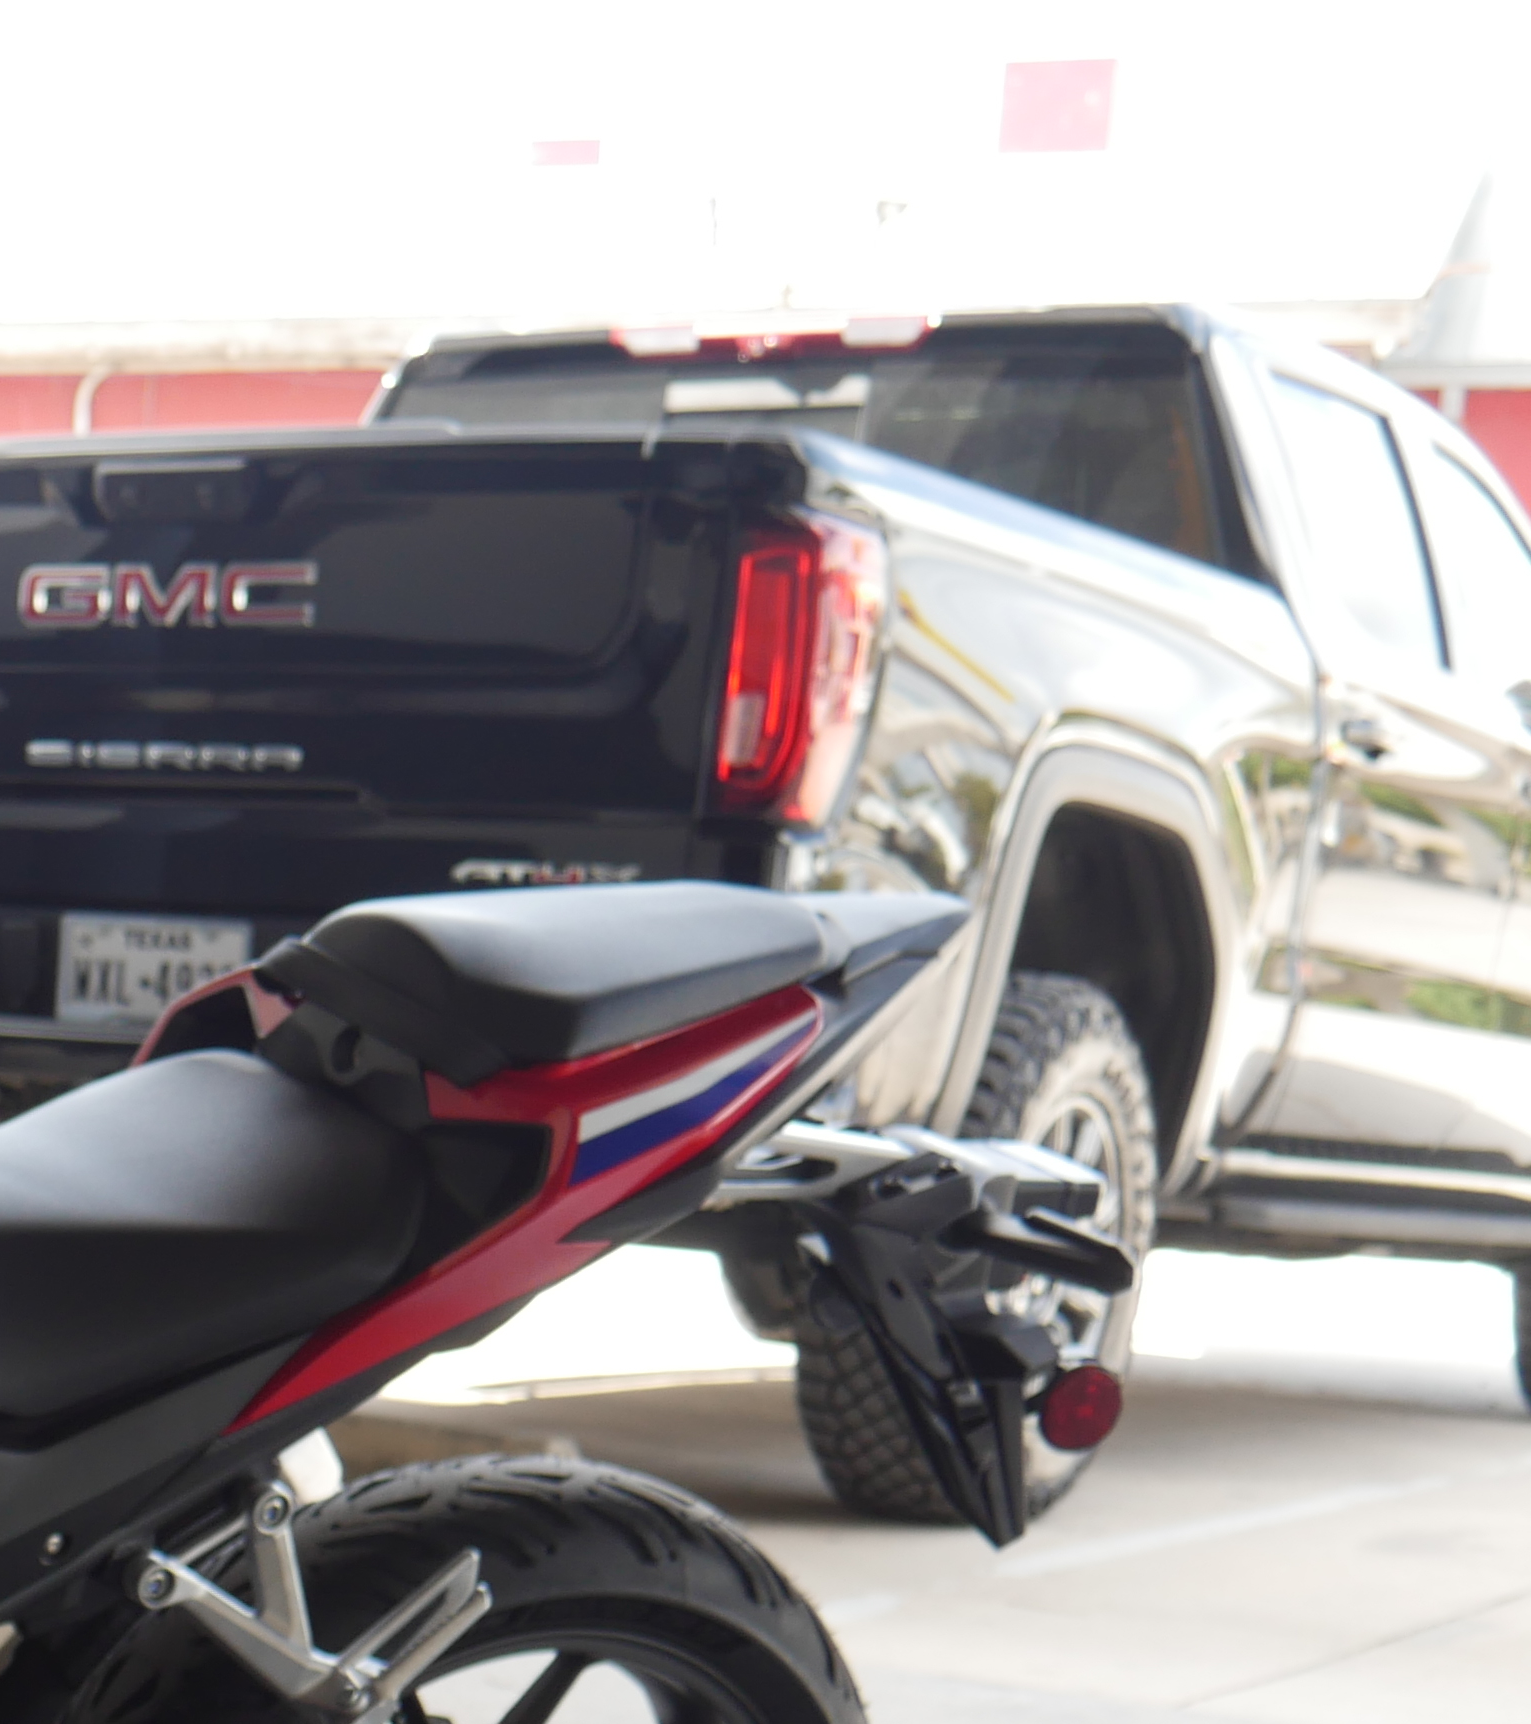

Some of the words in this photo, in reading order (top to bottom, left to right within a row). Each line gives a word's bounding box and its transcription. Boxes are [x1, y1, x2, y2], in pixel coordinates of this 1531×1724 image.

[17, 561, 319, 628] GMC
[25, 739, 303, 772] SIERRA
[124, 928, 192, 950] TEXAS
